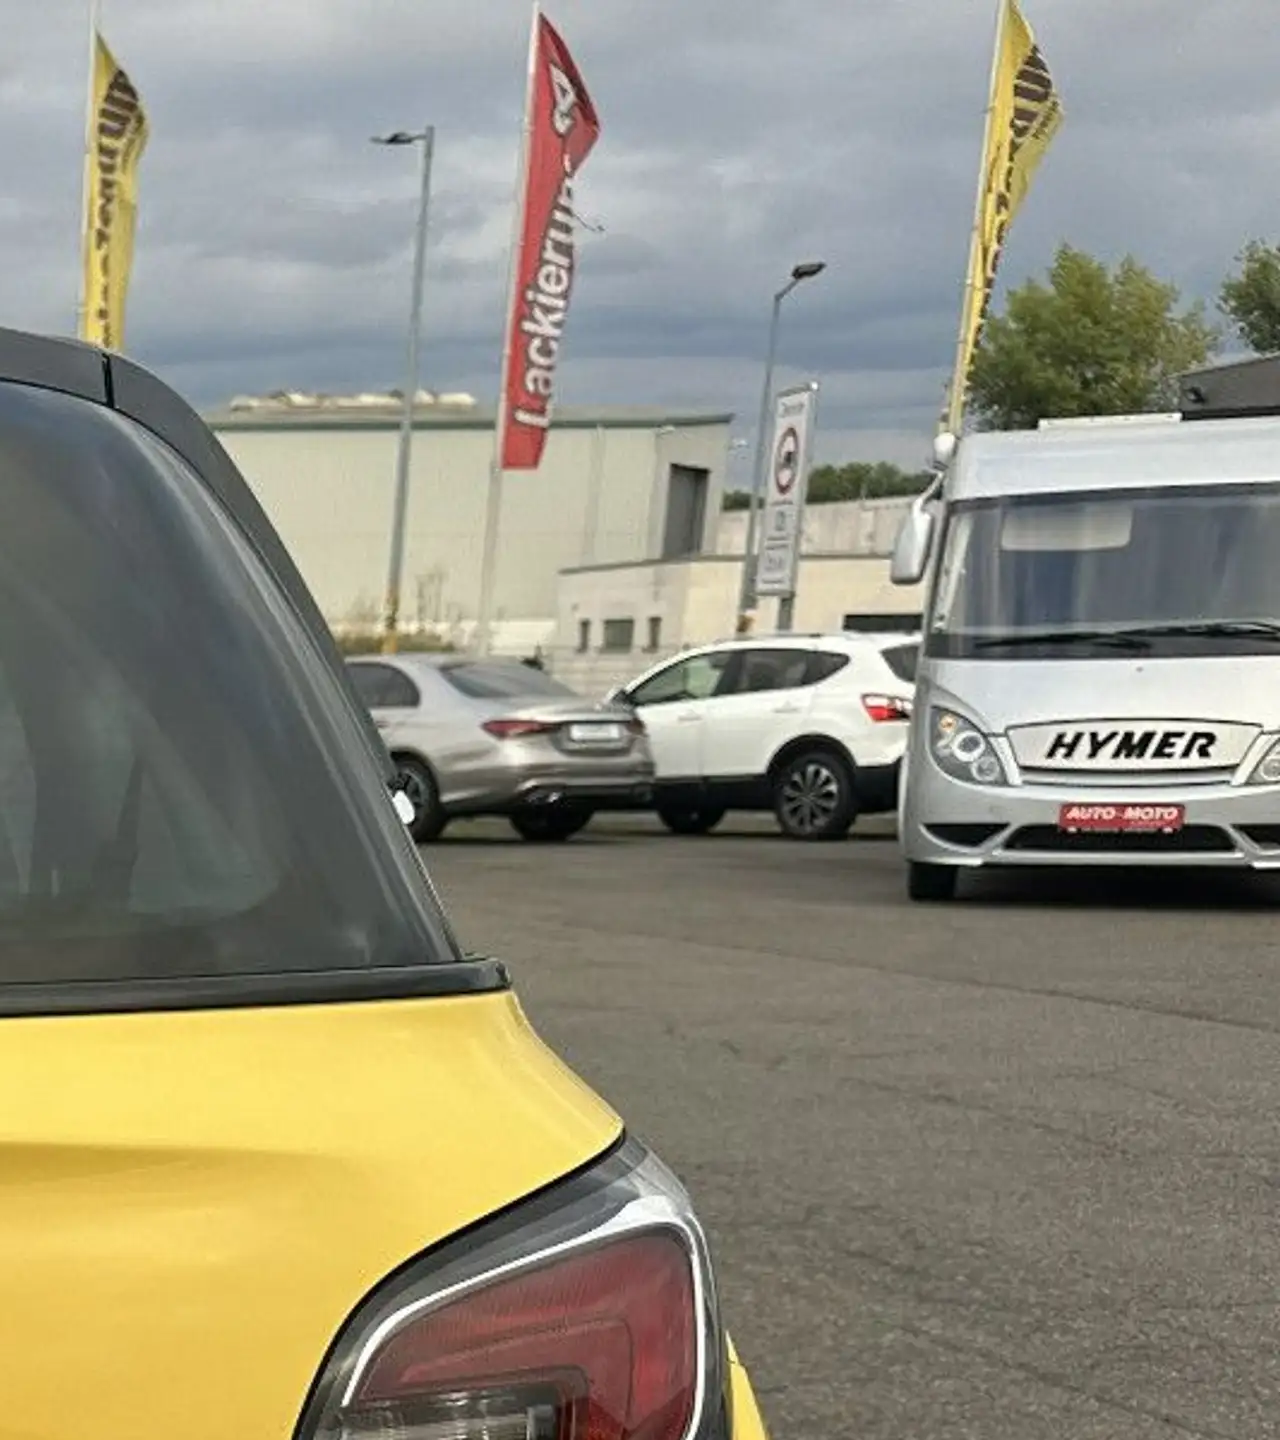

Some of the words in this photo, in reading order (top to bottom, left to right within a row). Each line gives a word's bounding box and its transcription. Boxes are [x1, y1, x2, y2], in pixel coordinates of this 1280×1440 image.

[1045, 731, 1217, 760] HYMER
[1065, 806, 1117, 820] AUTO
[1122, 806, 1179, 820] MOTO
